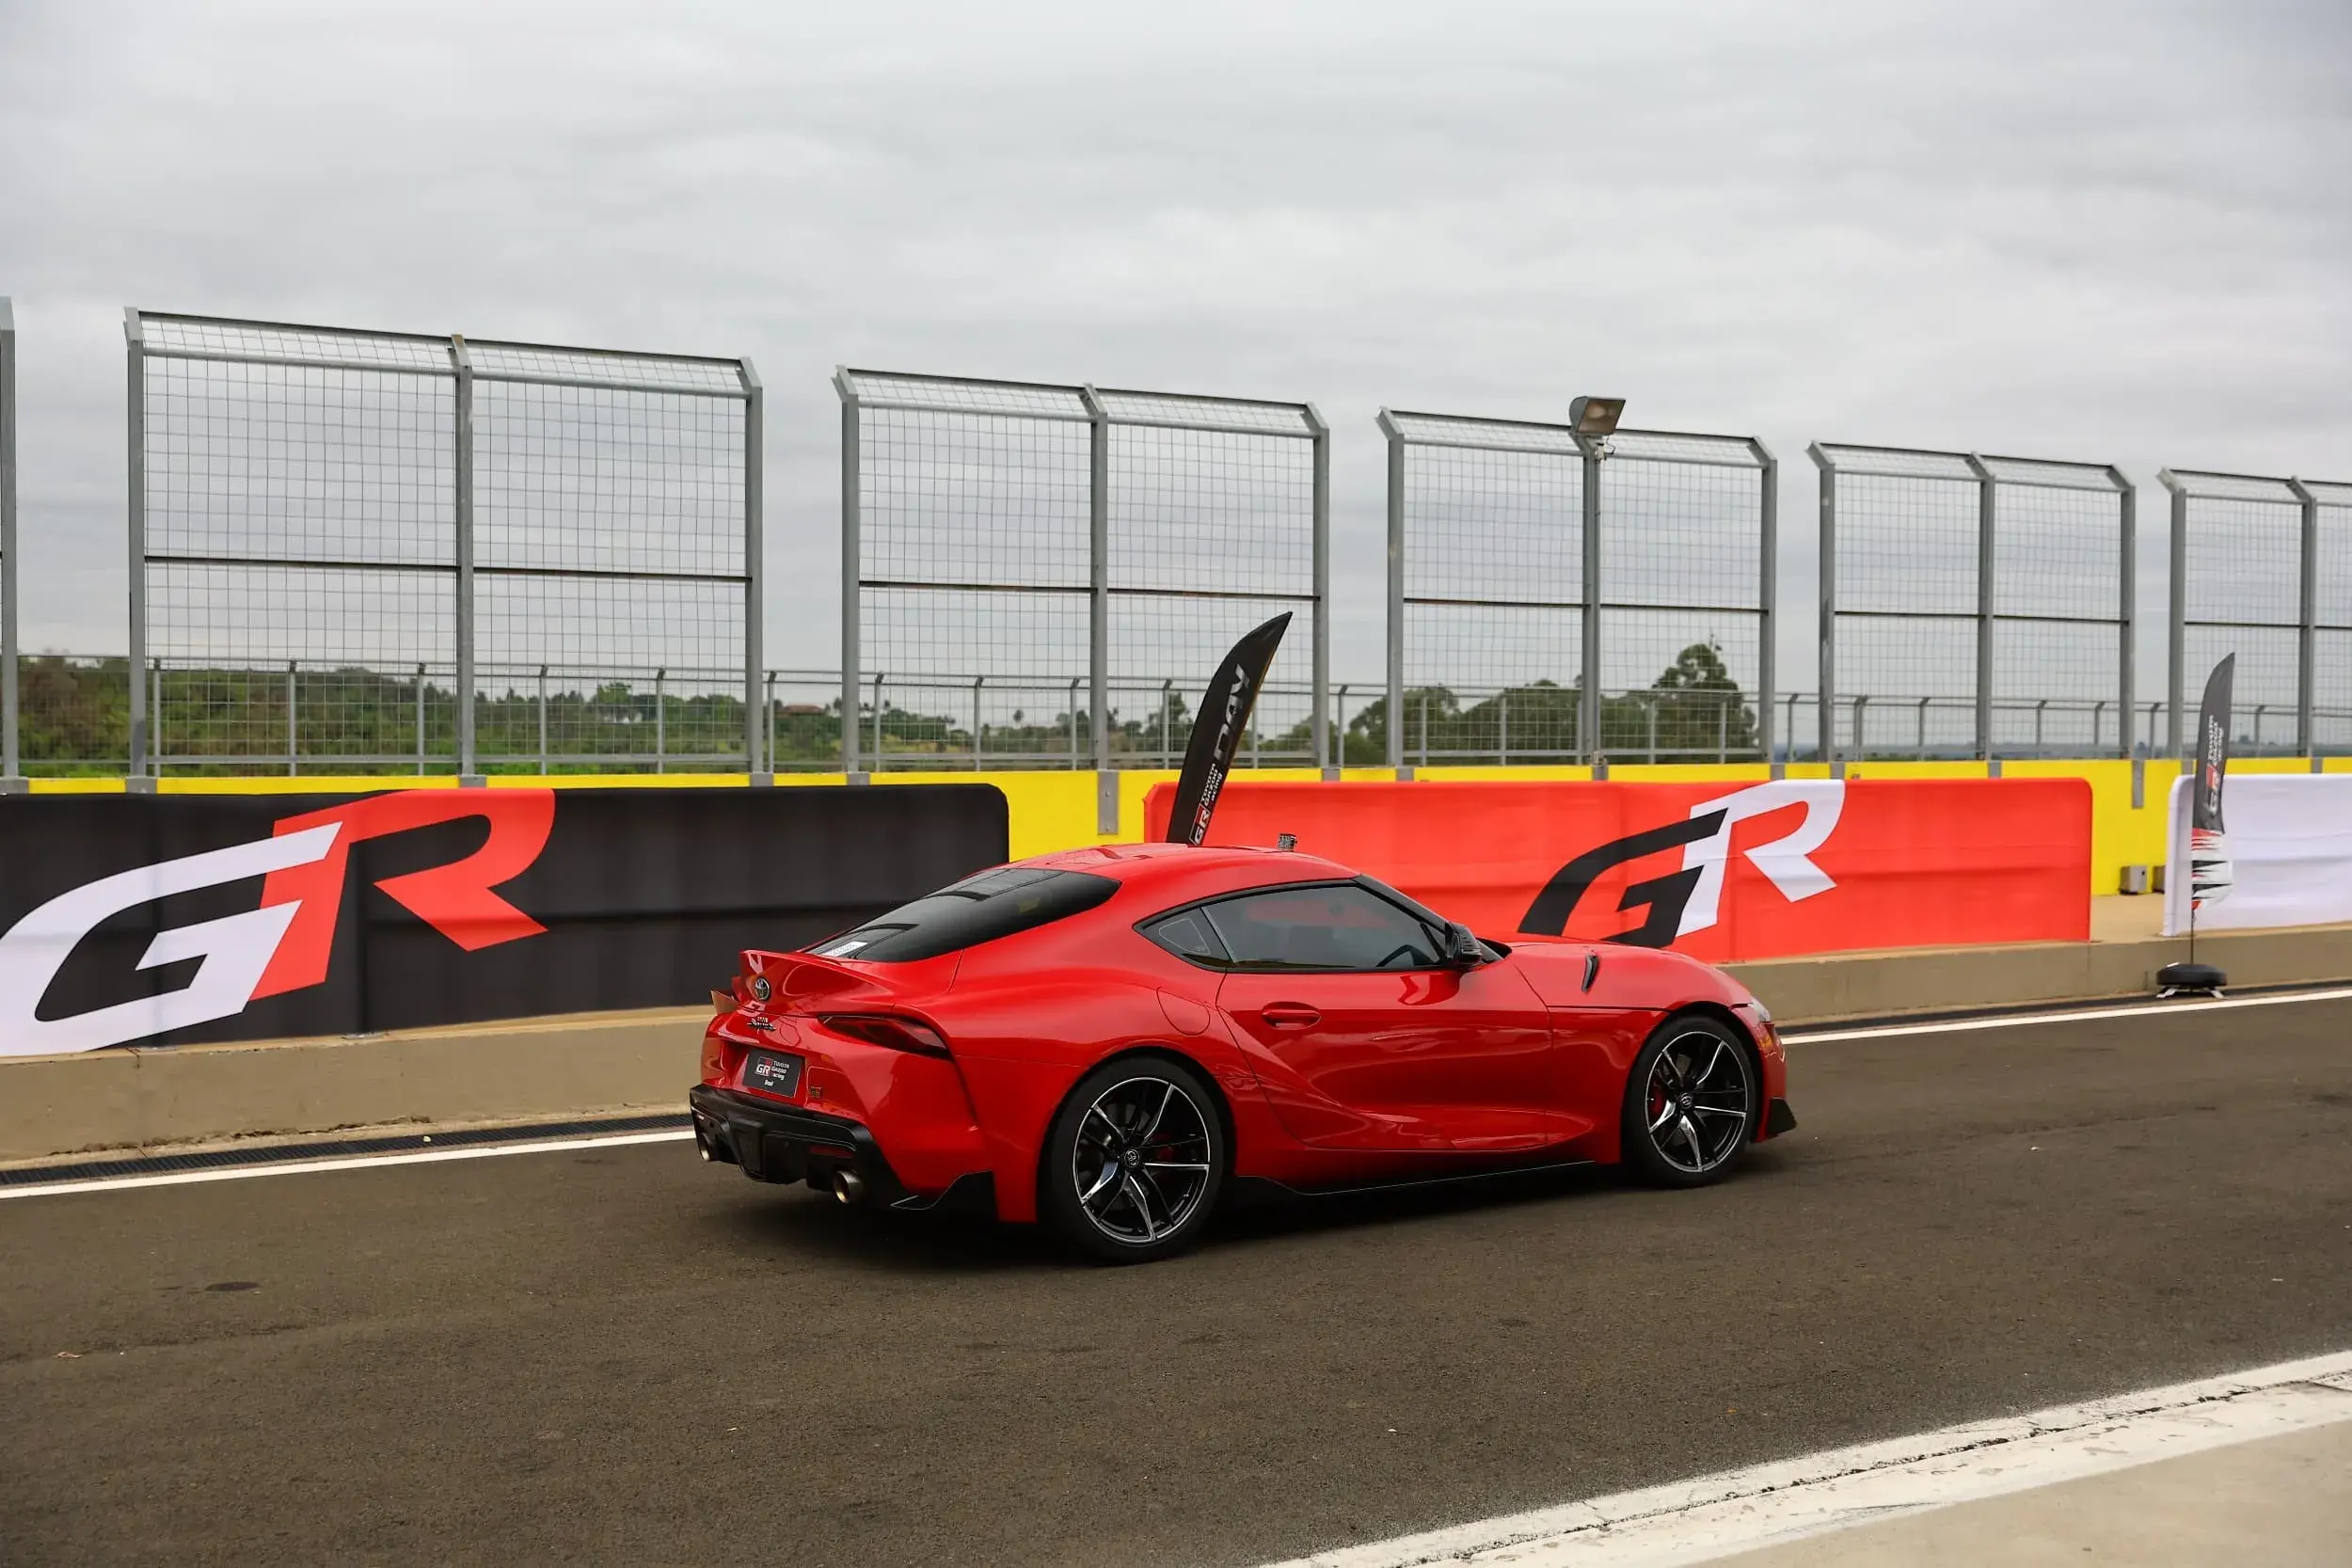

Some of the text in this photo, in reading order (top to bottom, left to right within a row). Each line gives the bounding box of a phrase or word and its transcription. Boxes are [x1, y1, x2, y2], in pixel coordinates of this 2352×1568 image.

[1214, 663, 1249, 765] DAY
[1200, 763, 1216, 802] TOYOTA
[1203, 768, 1219, 807] GAZOO
[1193, 811, 1211, 845] GR
[1518, 779, 1845, 949] GR
[0, 788, 555, 1055] GR
[755, 1063, 771, 1076] GR
